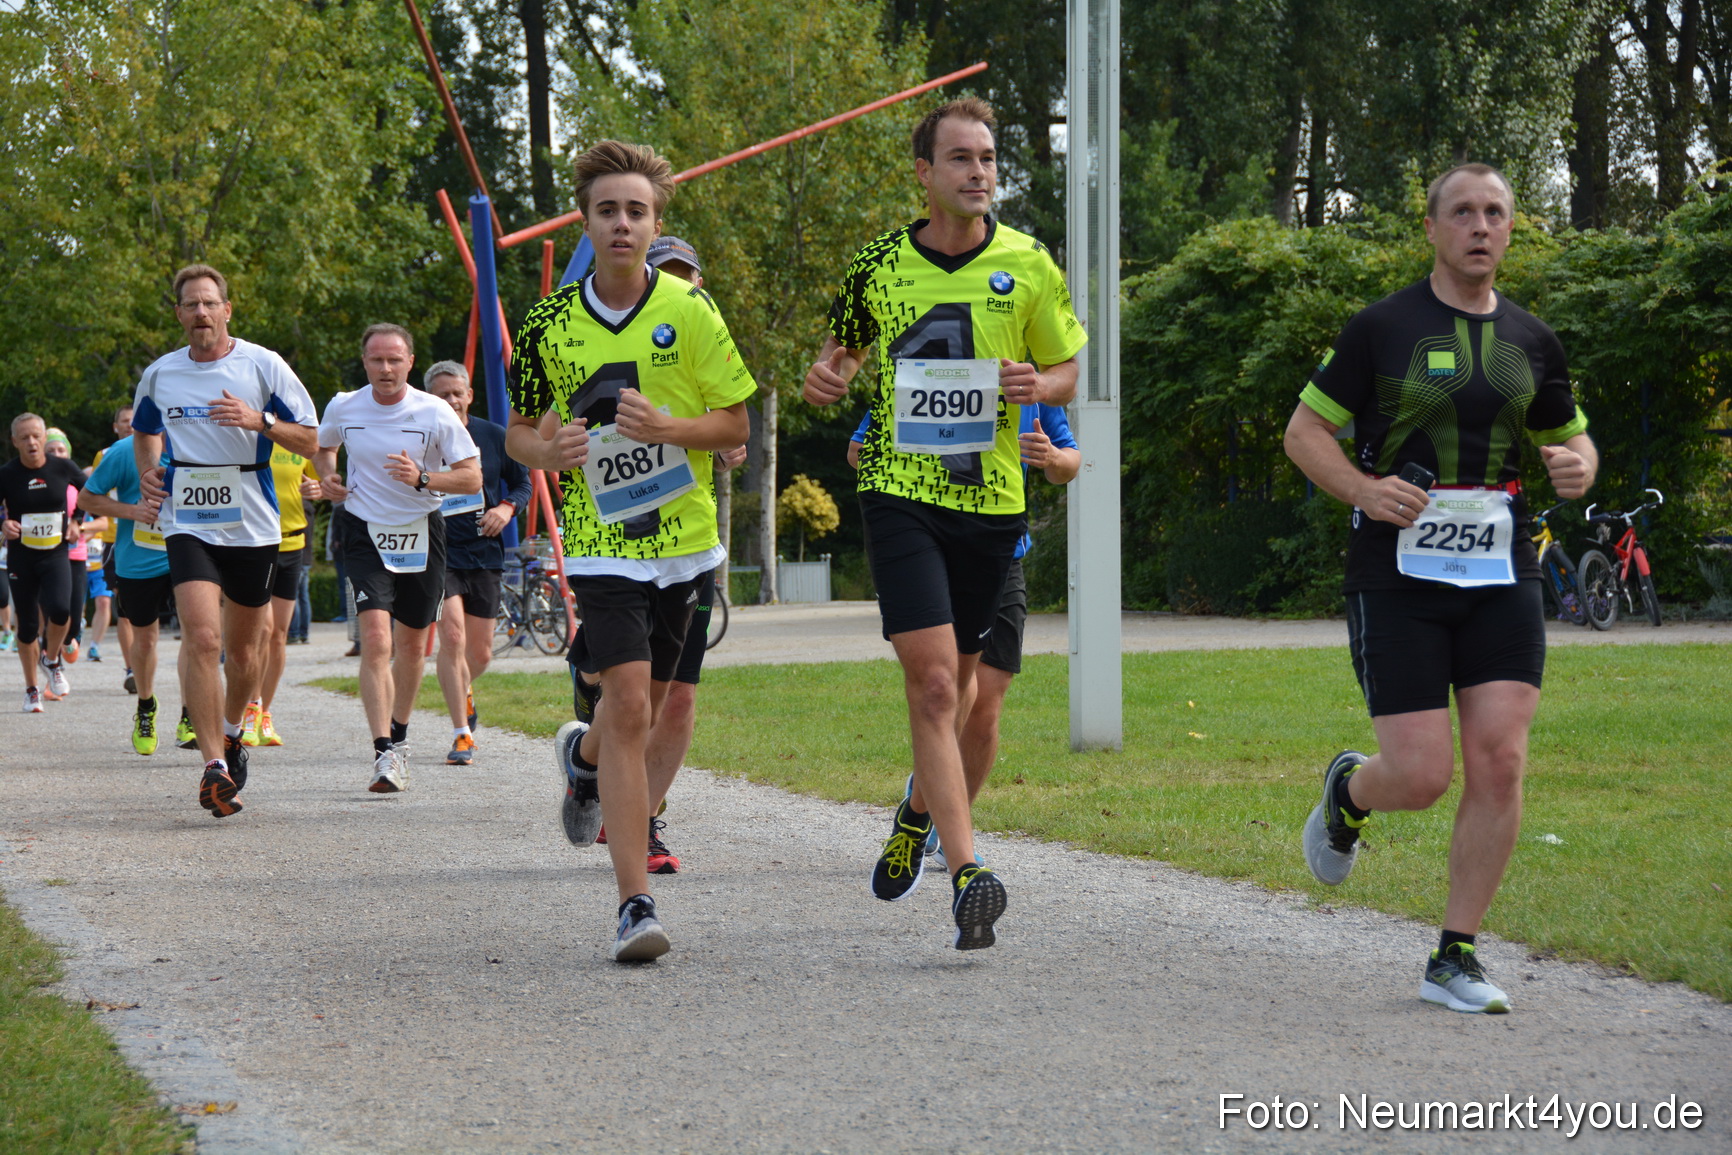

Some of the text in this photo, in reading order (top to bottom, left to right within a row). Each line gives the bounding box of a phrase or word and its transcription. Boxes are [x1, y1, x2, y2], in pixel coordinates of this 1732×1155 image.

[986, 297, 1014, 309] Partl
[986, 307, 1013, 315] Neumarkt
[651, 351, 678, 362] Partl
[934, 368, 970, 377] BOCK
[1428, 368, 1456, 376] DATEV
[910, 389, 983, 418] 2690
[938, 428, 955, 438] Kai
[597, 443, 664, 486] 2687
[182, 486, 232, 506] 2008
[628, 483, 660, 500] Lukas
[447, 498, 467, 506] Ludwig
[1447, 500, 1484, 510] BOCK
[197, 512, 219, 520] Stefan
[31, 525, 54, 537] 412
[1415, 521, 1495, 552] 2254
[376, 533, 419, 550] 2577
[1442, 561, 1467, 574] Jörg
